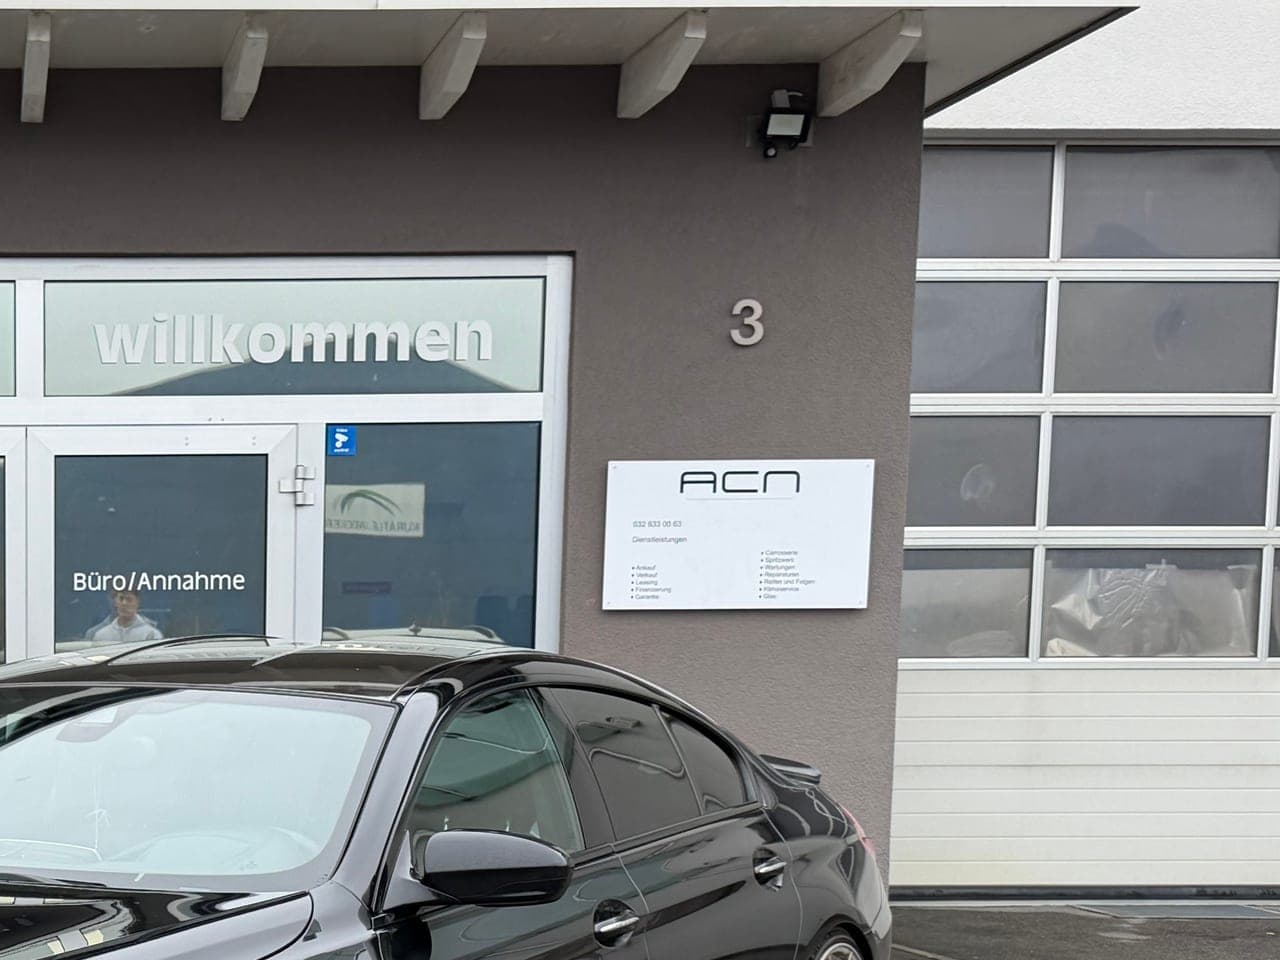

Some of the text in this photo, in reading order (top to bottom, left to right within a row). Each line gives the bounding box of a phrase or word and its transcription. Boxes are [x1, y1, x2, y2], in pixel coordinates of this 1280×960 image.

[730, 299, 765, 347] 3
[93, 313, 493, 365] willkommen
[680, 470, 800, 493] ACN
[632, 536, 688, 544] Dienstleistungen
[72, 570, 245, 592] Büro/Annahme
